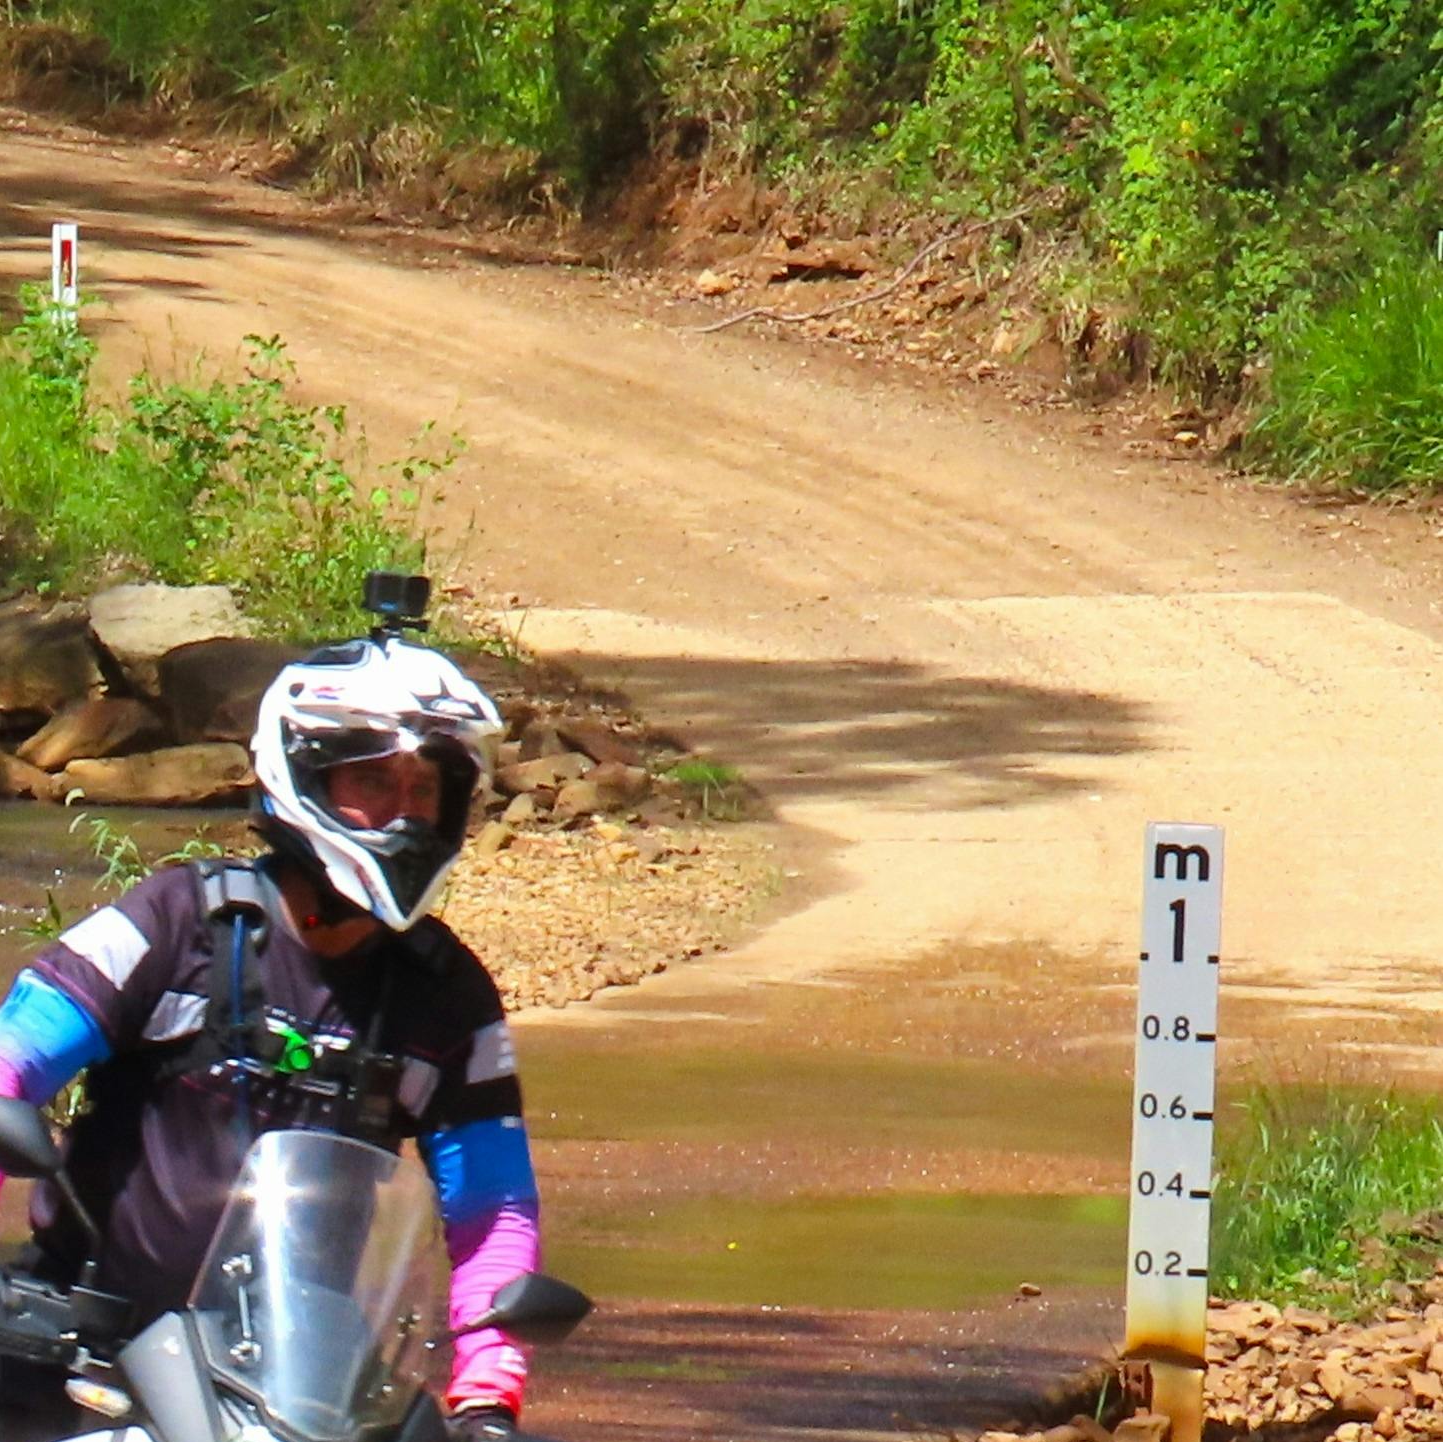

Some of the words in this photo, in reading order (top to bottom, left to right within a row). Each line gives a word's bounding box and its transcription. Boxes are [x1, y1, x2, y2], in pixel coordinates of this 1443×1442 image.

[1154, 843, 1210, 882] m
[1169, 899, 1186, 963] 1
[1143, 1015, 1190, 1041] 0.8
[1140, 1094, 1187, 1119] 0.6
[1138, 1172, 1183, 1197] 0.4
[1135, 1251, 1181, 1276] 0.2
